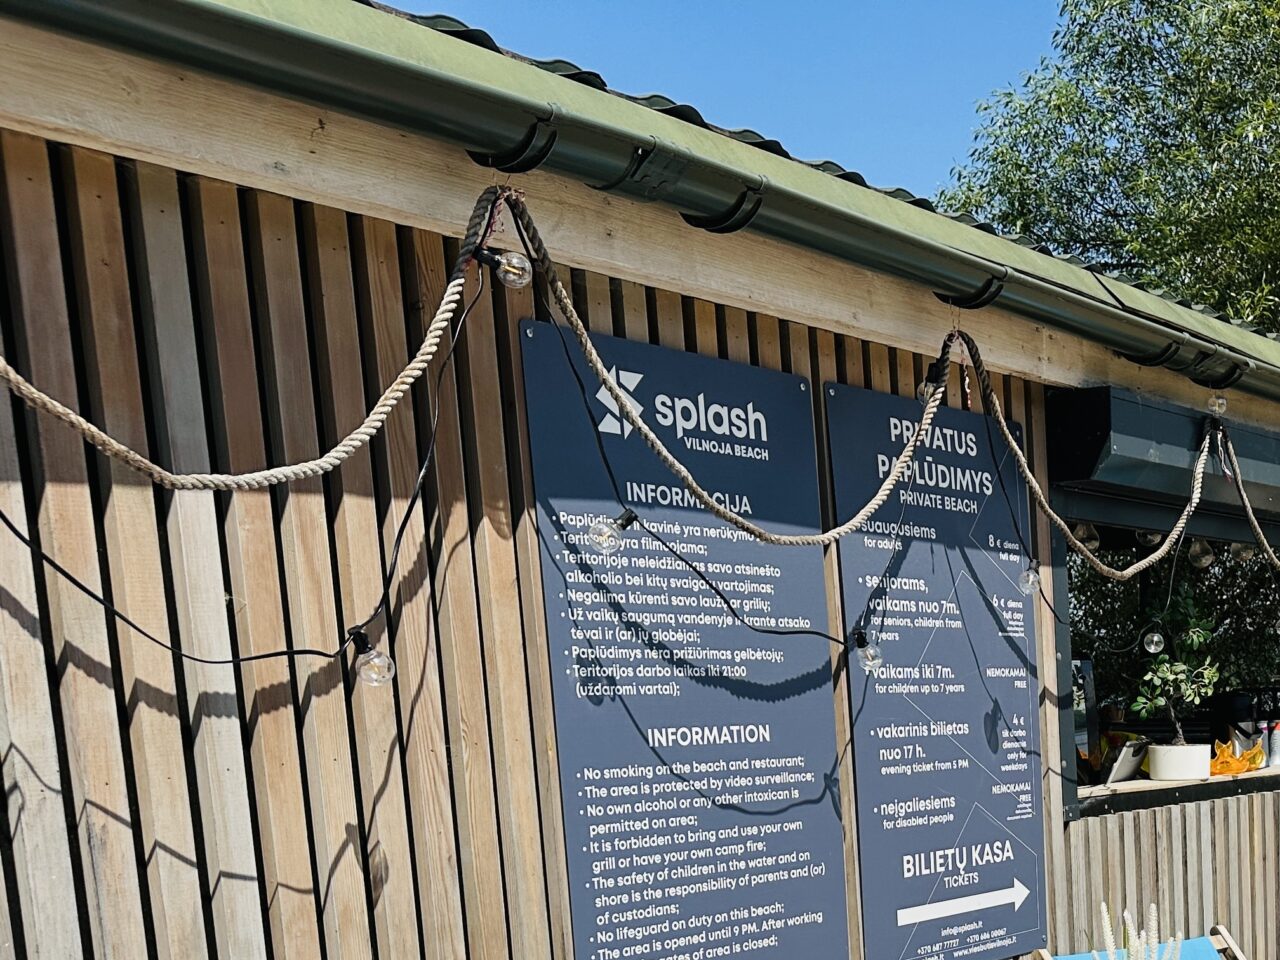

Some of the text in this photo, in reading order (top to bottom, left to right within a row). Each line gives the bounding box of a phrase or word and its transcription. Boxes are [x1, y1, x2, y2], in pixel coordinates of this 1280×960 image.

[654, 393, 768, 442] splash
[684, 436, 768, 460] VILNOJA BEACH
[899, 489, 977, 513] PRIVATE BEACH
[863, 535, 876, 547] for
[865, 574, 927, 592] senjorams,
[869, 595, 959, 614] vaikams nuo 7m.
[870, 612, 961, 627] for seniors, children from
[570, 626, 699, 643] tėvai ir (ar) jų globėjai;
[870, 629, 898, 641] 7 years
[571, 645, 783, 662] Paplūdimys nėra prižiūrimas gelbėtojų;
[572, 663, 746, 679] Teritorijos darbo laikas iki 21:00
[872, 663, 954, 678] vaikams iki 7m.
[986, 667, 1025, 677] NEMOKAMAI
[576, 681, 679, 698] (uždaromi vartai);
[875, 683, 964, 694] for children up to 7 years
[1014, 680, 1026, 688] FREE
[1012, 713, 1018, 725] 4
[648, 724, 769, 746] INFORMATION
[876, 721, 968, 738] vakarinis bilietas
[879, 744, 925, 760] nuo 17 h.
[583, 756, 804, 780] No smoking on the beach and restaurant;
[880, 758, 968, 775] evening ticket from 5 PM
[584, 771, 814, 798] The area is protected by video surveillance;
[992, 782, 1030, 793] NEMOKAMAI
[880, 796, 954, 816] neįgaliesiems
[1018, 793, 1031, 802] FREE
[589, 815, 697, 837] permitted on area;
[882, 812, 953, 829] for disabled people
[592, 840, 766, 874] grill or have your own camp fire;
[903, 840, 1013, 877] BILIETŲ KASA
[591, 851, 810, 889] The safety of children in the water and on
[595, 862, 825, 907] shore is the responsibility of parents and (or)
[943, 872, 978, 888] TICKETS
[596, 904, 679, 925] of custodians;
[596, 902, 783, 943] No lifeguard on duty on this beach;
[597, 912, 822, 960] The area is opened until 9 PM. After working
[692, 947, 703, 960] of
[705, 945, 730, 958] area
[732, 941, 740, 952] is
[742, 934, 777, 950] closed;
